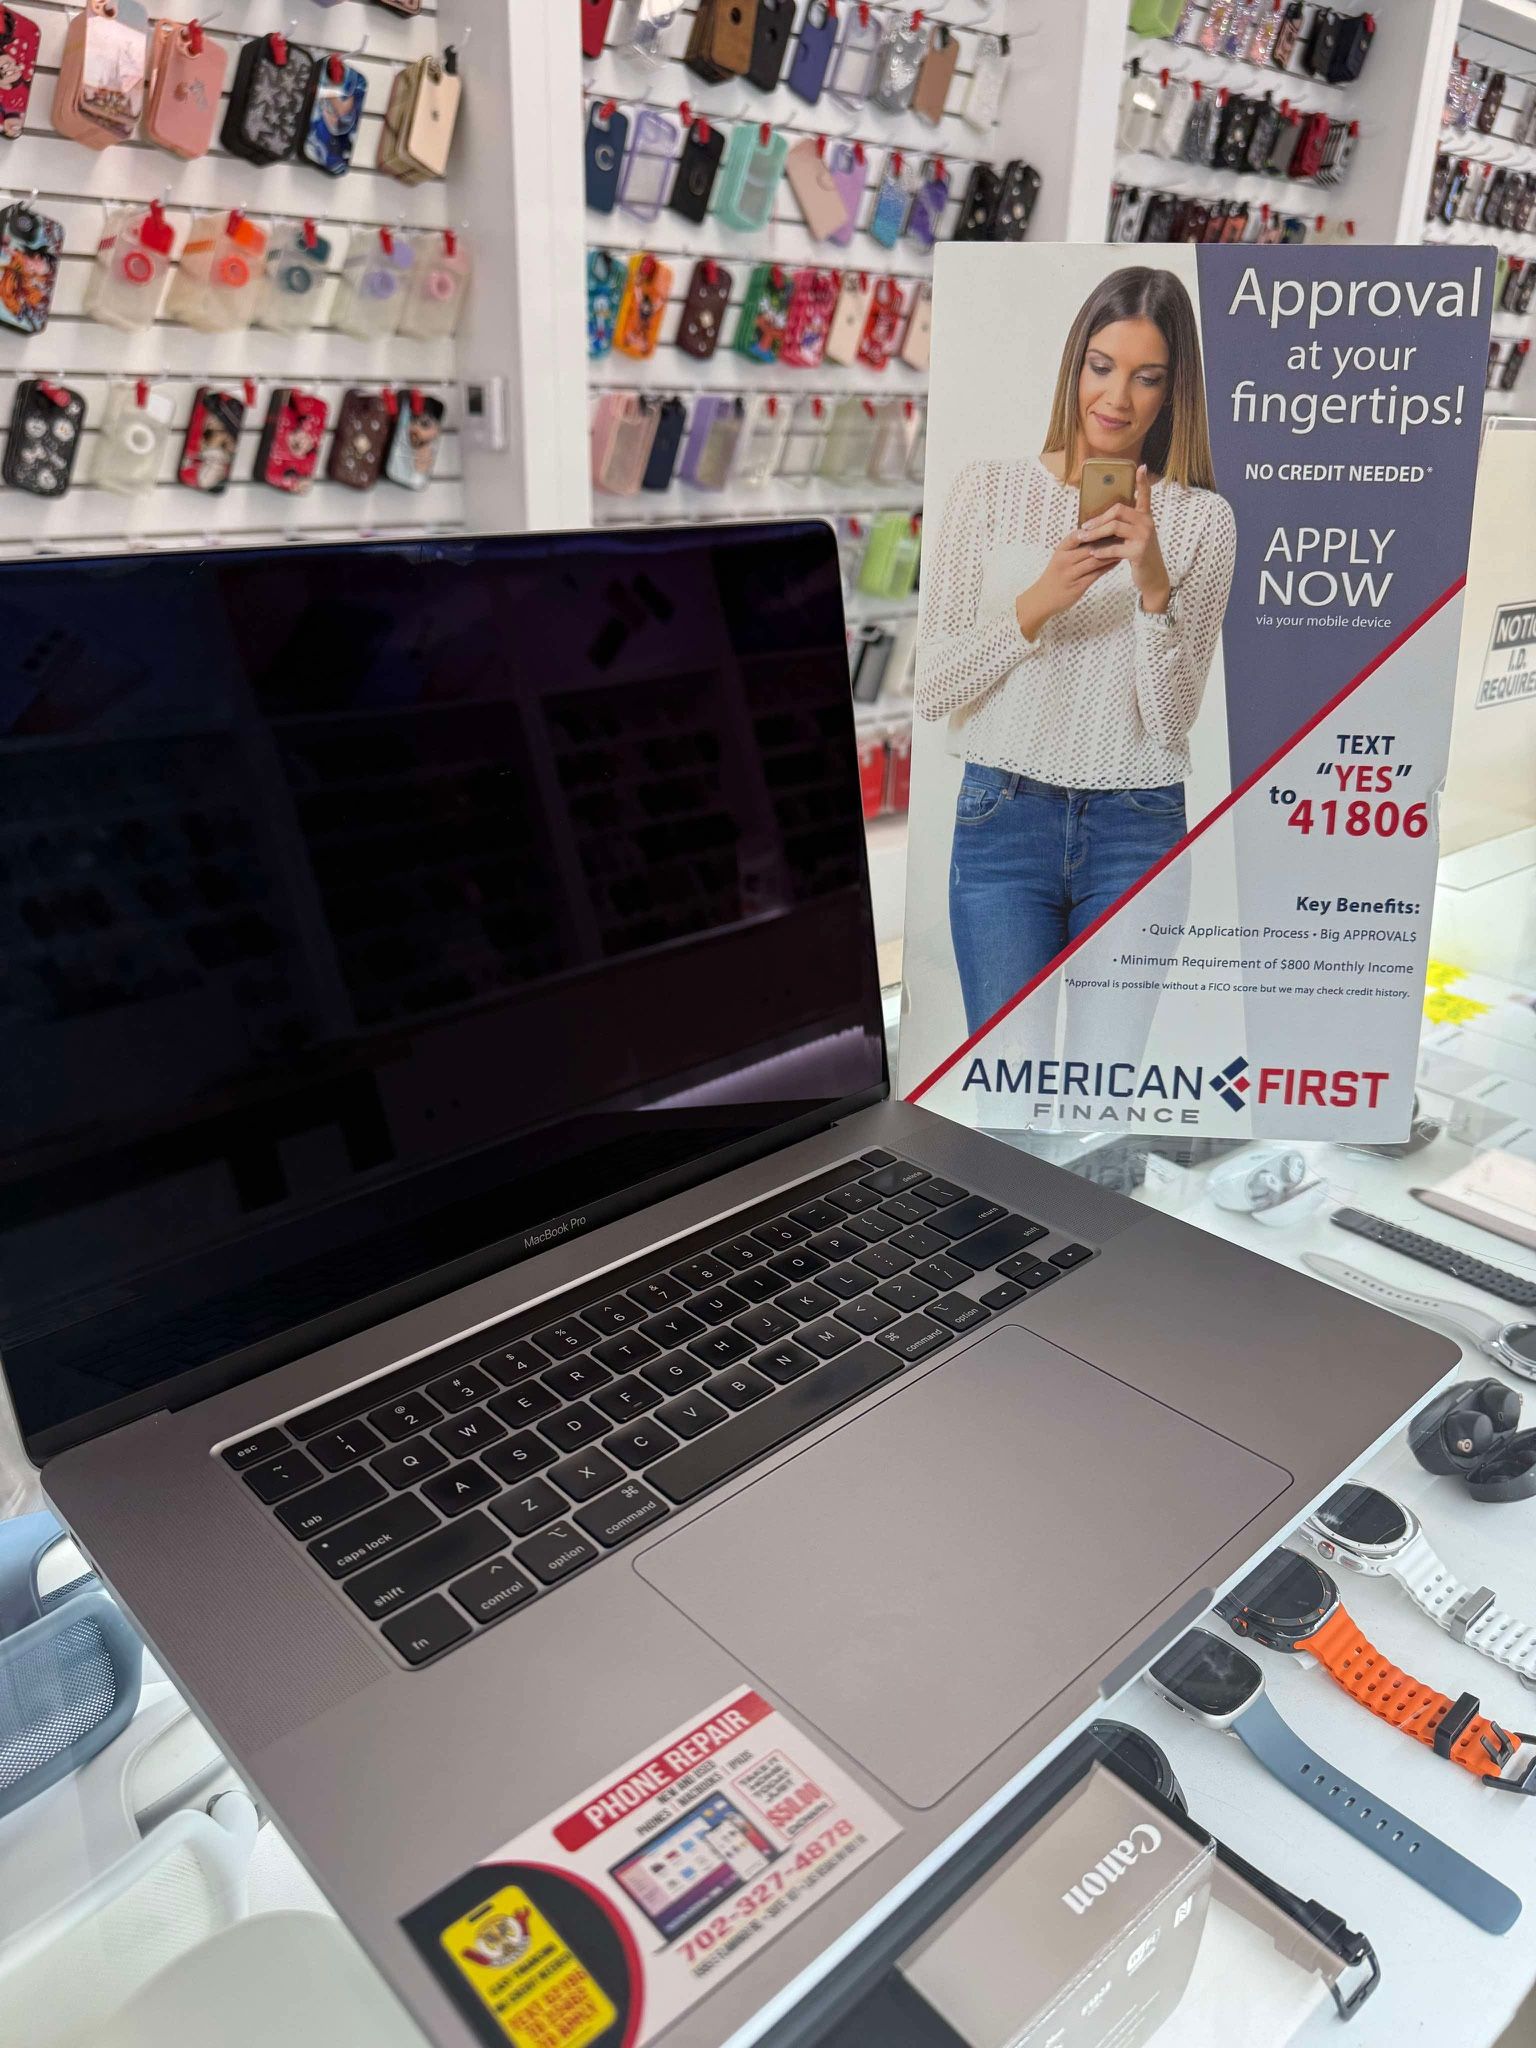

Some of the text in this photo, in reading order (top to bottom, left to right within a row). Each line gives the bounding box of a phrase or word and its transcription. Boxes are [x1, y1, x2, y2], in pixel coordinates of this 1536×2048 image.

[1228, 267, 1482, 329] Approval
[1287, 341, 1417, 379] at your
[1231, 381, 1464, 434] fingertips!
[1245, 463, 1274, 480] NO
[1278, 464, 1345, 481] CREDIT
[1264, 527, 1396, 564] APPLY
[1258, 570, 1394, 607] NOW
[1256, 615, 1392, 628] via your mobile device
[1337, 735, 1395, 755] TEXT
[1269, 786, 1428, 838] to 41806
[1296, 896, 1420, 916] Key Benefits:
[1149, 924, 1185, 936] Quick
[1188, 925, 1259, 938] Application
[1263, 927, 1309, 939] Process
[1320, 929, 1340, 942] Big
[1120, 954, 1414, 975] Minimum Requirement of $800 Monthly Income
[1113, 980, 1119, 988] is
[1122, 980, 1160, 990] possible
[1162, 982, 1199, 991] without
[1208, 983, 1231, 991] FICO
[1260, 984, 1276, 993] but
[1278, 986, 1292, 994] we
[1294, 986, 1314, 996] may
[1316, 986, 1344, 995] check
[1346, 987, 1373, 996] credit
[1375, 988, 1410, 998] history.
[962, 1058, 1390, 1108] AMERICAN FIRST
[1033, 1103, 1200, 1124] FINANCE
[523, 1216, 587, 1249] MacBook Pro
[345, 1443, 356, 1454] 1
[404, 1414, 418, 1425] 2
[461, 1387, 474, 1397] 3
[516, 1361, 528, 1370] 4
[566, 1337, 578, 1345] 5
[613, 1313, 626, 1321] 6
[657, 1291, 668, 1299] 7
[701, 1270, 713, 1278] 8
[742, 1250, 753, 1258] 9
[301, 1514, 323, 1529] tab
[402, 1455, 420, 1467] Q
[458, 1424, 478, 1437] W
[517, 1397, 532, 1408] E
[569, 1371, 585, 1381] R
[618, 1345, 632, 1355] T
[665, 1322, 678, 1332] Y
[709, 1299, 723, 1309] U
[792, 1258, 804, 1267] O
[830, 1240, 839, 1248] P
[336, 1206, 999, 1567] caps lock A S D F G H J K L return
[374, 1585, 406, 1607] shift
[521, 1499, 540, 1512] Z
[578, 1467, 596, 1479] X
[633, 1436, 649, 1447] C
[683, 1407, 697, 1418] V
[732, 1381, 746, 1391] B
[776, 1355, 792, 1366] N
[818, 1331, 835, 1342] M
[1023, 1225, 1040, 1237] shift
[237, 1444, 258, 1458] esc
[411, 1306, 979, 1651] fn control option command command option
[583, 1709, 750, 1830] PHONE REPAIR
[677, 1776, 697, 1791] AND
[1061, 1823, 1162, 1915] Canon
[677, 1819, 855, 1962] 702-327-4878
